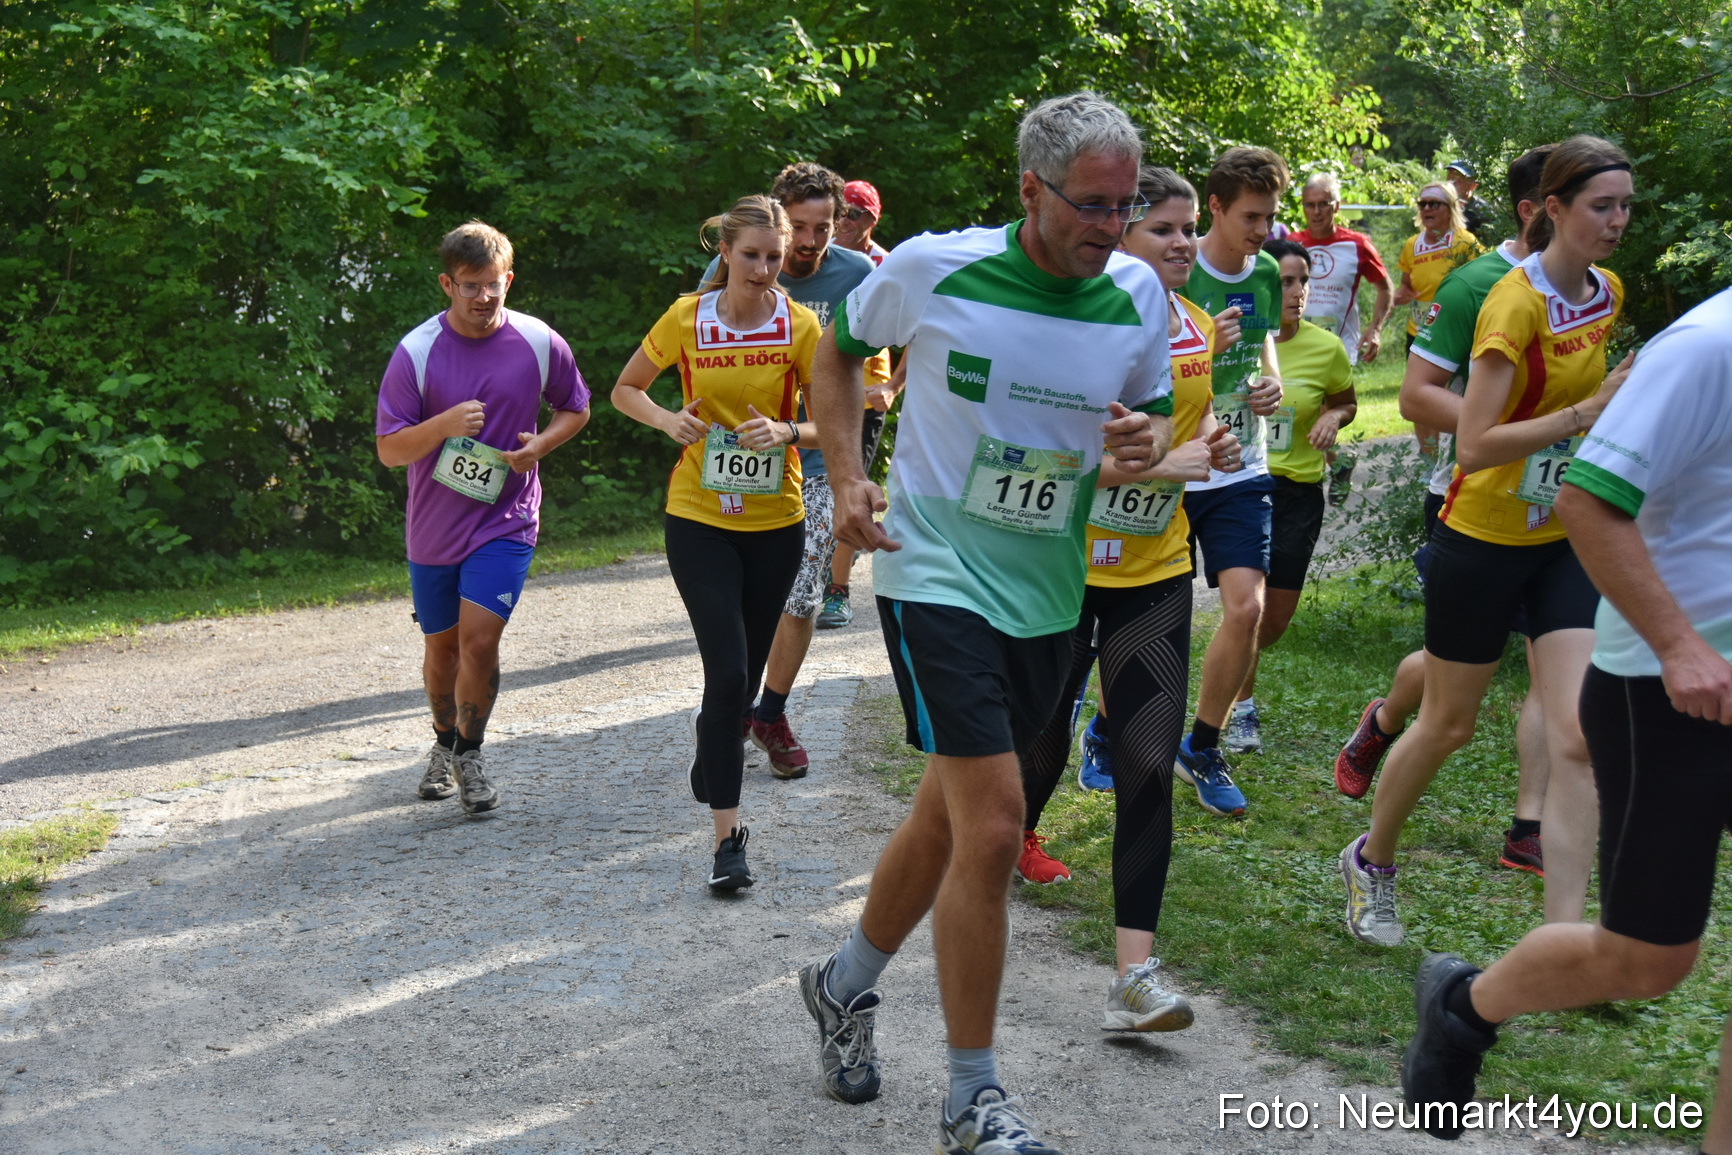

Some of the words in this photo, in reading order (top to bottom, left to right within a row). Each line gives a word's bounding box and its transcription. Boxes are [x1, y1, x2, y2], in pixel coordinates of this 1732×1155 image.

[1235, 340, 1264, 352] Firm
[1553, 335, 1587, 357] MAX
[1586, 324, 1612, 345] BÖG
[695, 355, 737, 369] MAX
[743, 350, 791, 367] BÖGL
[1179, 358, 1211, 379] BÖG
[947, 365, 987, 385] BayWa
[1010, 382, 1042, 396] BayWa
[1043, 388, 1087, 402] Baustoffe
[1008, 391, 1038, 404] Immer
[1039, 397, 1053, 406] ein
[1054, 400, 1080, 411] gutes
[1080, 404, 1109, 414] Bauge
[1271, 423, 1280, 440] 1
[452, 455, 493, 486] 634
[714, 452, 772, 478] 1601
[991, 455, 1039, 474] firmenlauf
[1538, 458, 1570, 487] 16
[448, 472, 469, 486] Holstein
[469, 482, 488, 492] Dennis
[735, 476, 760, 484] Jennifer
[1537, 484, 1560, 494] Pillho
[995, 474, 1057, 512] 116
[1106, 485, 1173, 518] 1617
[986, 502, 1016, 516] Lerzer
[1017, 509, 1051, 520] Günther
[1001, 515, 1024, 524] BayWa
[1105, 508, 1132, 521] Kramer
[1132, 515, 1158, 525] Susanne
[1122, 521, 1146, 529] Bauservice
